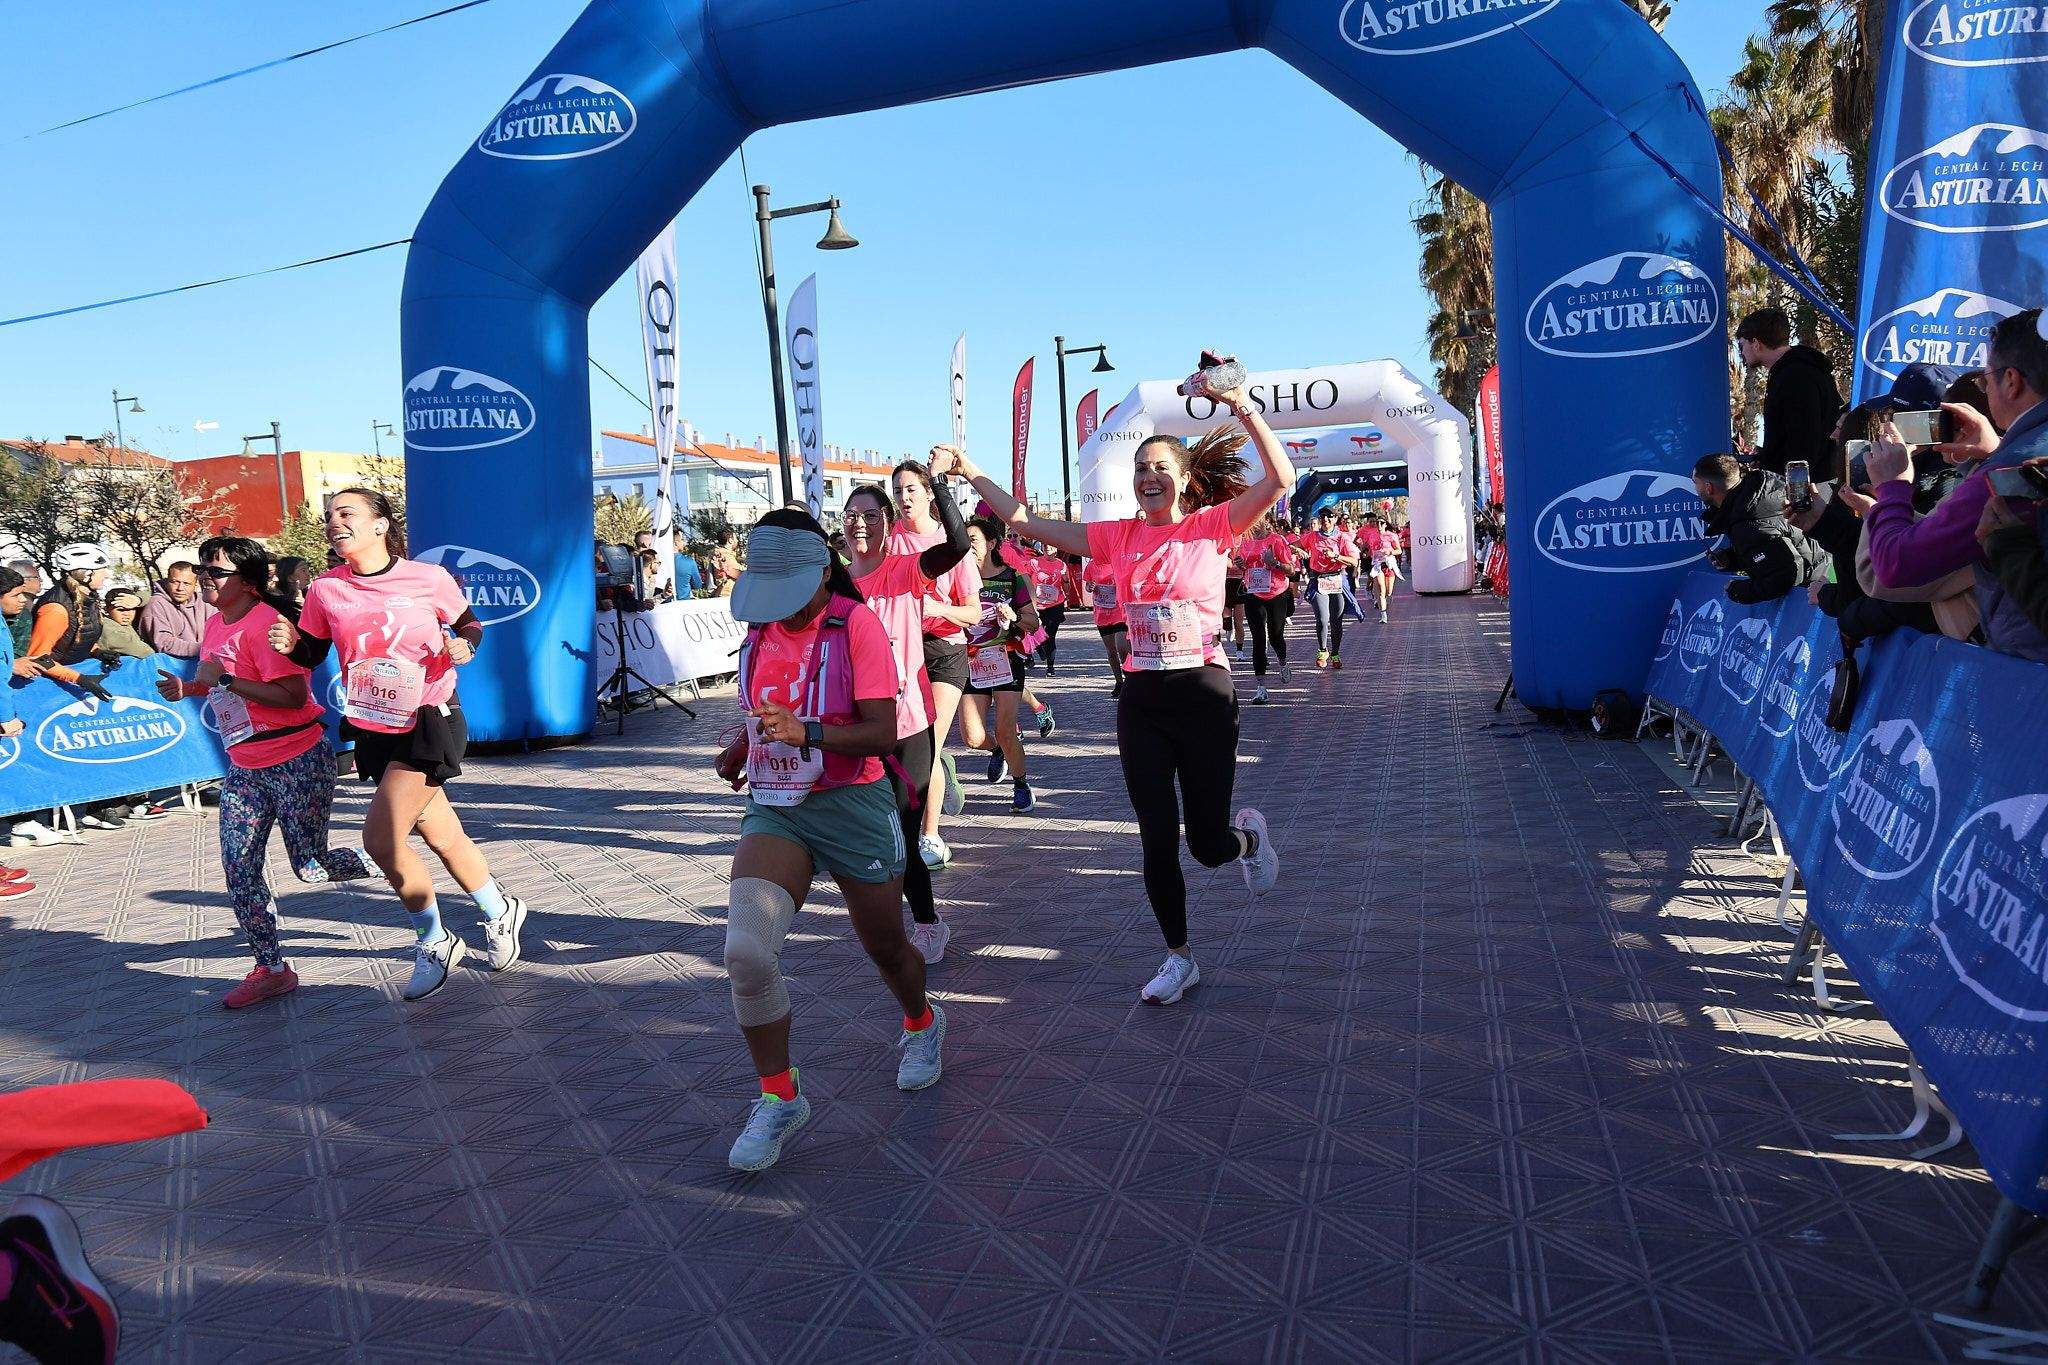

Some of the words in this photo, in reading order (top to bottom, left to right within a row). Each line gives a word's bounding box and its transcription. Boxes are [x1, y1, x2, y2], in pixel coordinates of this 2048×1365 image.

[1357, 0, 1548, 42] ASTUR
[507, 100, 553, 119] CENTRAL
[558, 97, 615, 109] LECHERA
[483, 110, 624, 147] ASTURIANA
[1934, 161, 1990, 176] CENTRAL
[1567, 288, 1640, 306] CENTRAL
[1646, 284, 1707, 296] LECHERA
[1537, 298, 1712, 342] ASTURIANA
[410, 396, 452, 407] CENTRAL
[456, 395, 516, 405] LECHERA
[1185, 379, 1339, 421] OSHO
[1386, 403, 1436, 419] OYSHO
[1017, 386, 1029, 471] Santander
[1488, 389, 1503, 459] Santander
[1099, 430, 1143, 443] OYSHO
[1328, 474, 1397, 485] VOLVO
[1083, 492, 1123, 504] OYSHO
[1575, 505, 1648, 520] CENTRAL
[1418, 534, 1464, 547] OYSHO
[1546, 513, 1719, 551] ASTURIAN
[682, 610, 748, 643] OYSH
[1150, 631, 1178, 644] 016
[982, 663, 999, 673] 016
[371, 686, 397, 700] 016
[69, 717, 117, 729] CENTRAL
[121, 711, 166, 723] LECHERA
[51, 720, 178, 751] ASTURIANA
[769, 757, 799, 771] 016
[1838, 752, 1922, 863] ASTURIANA
